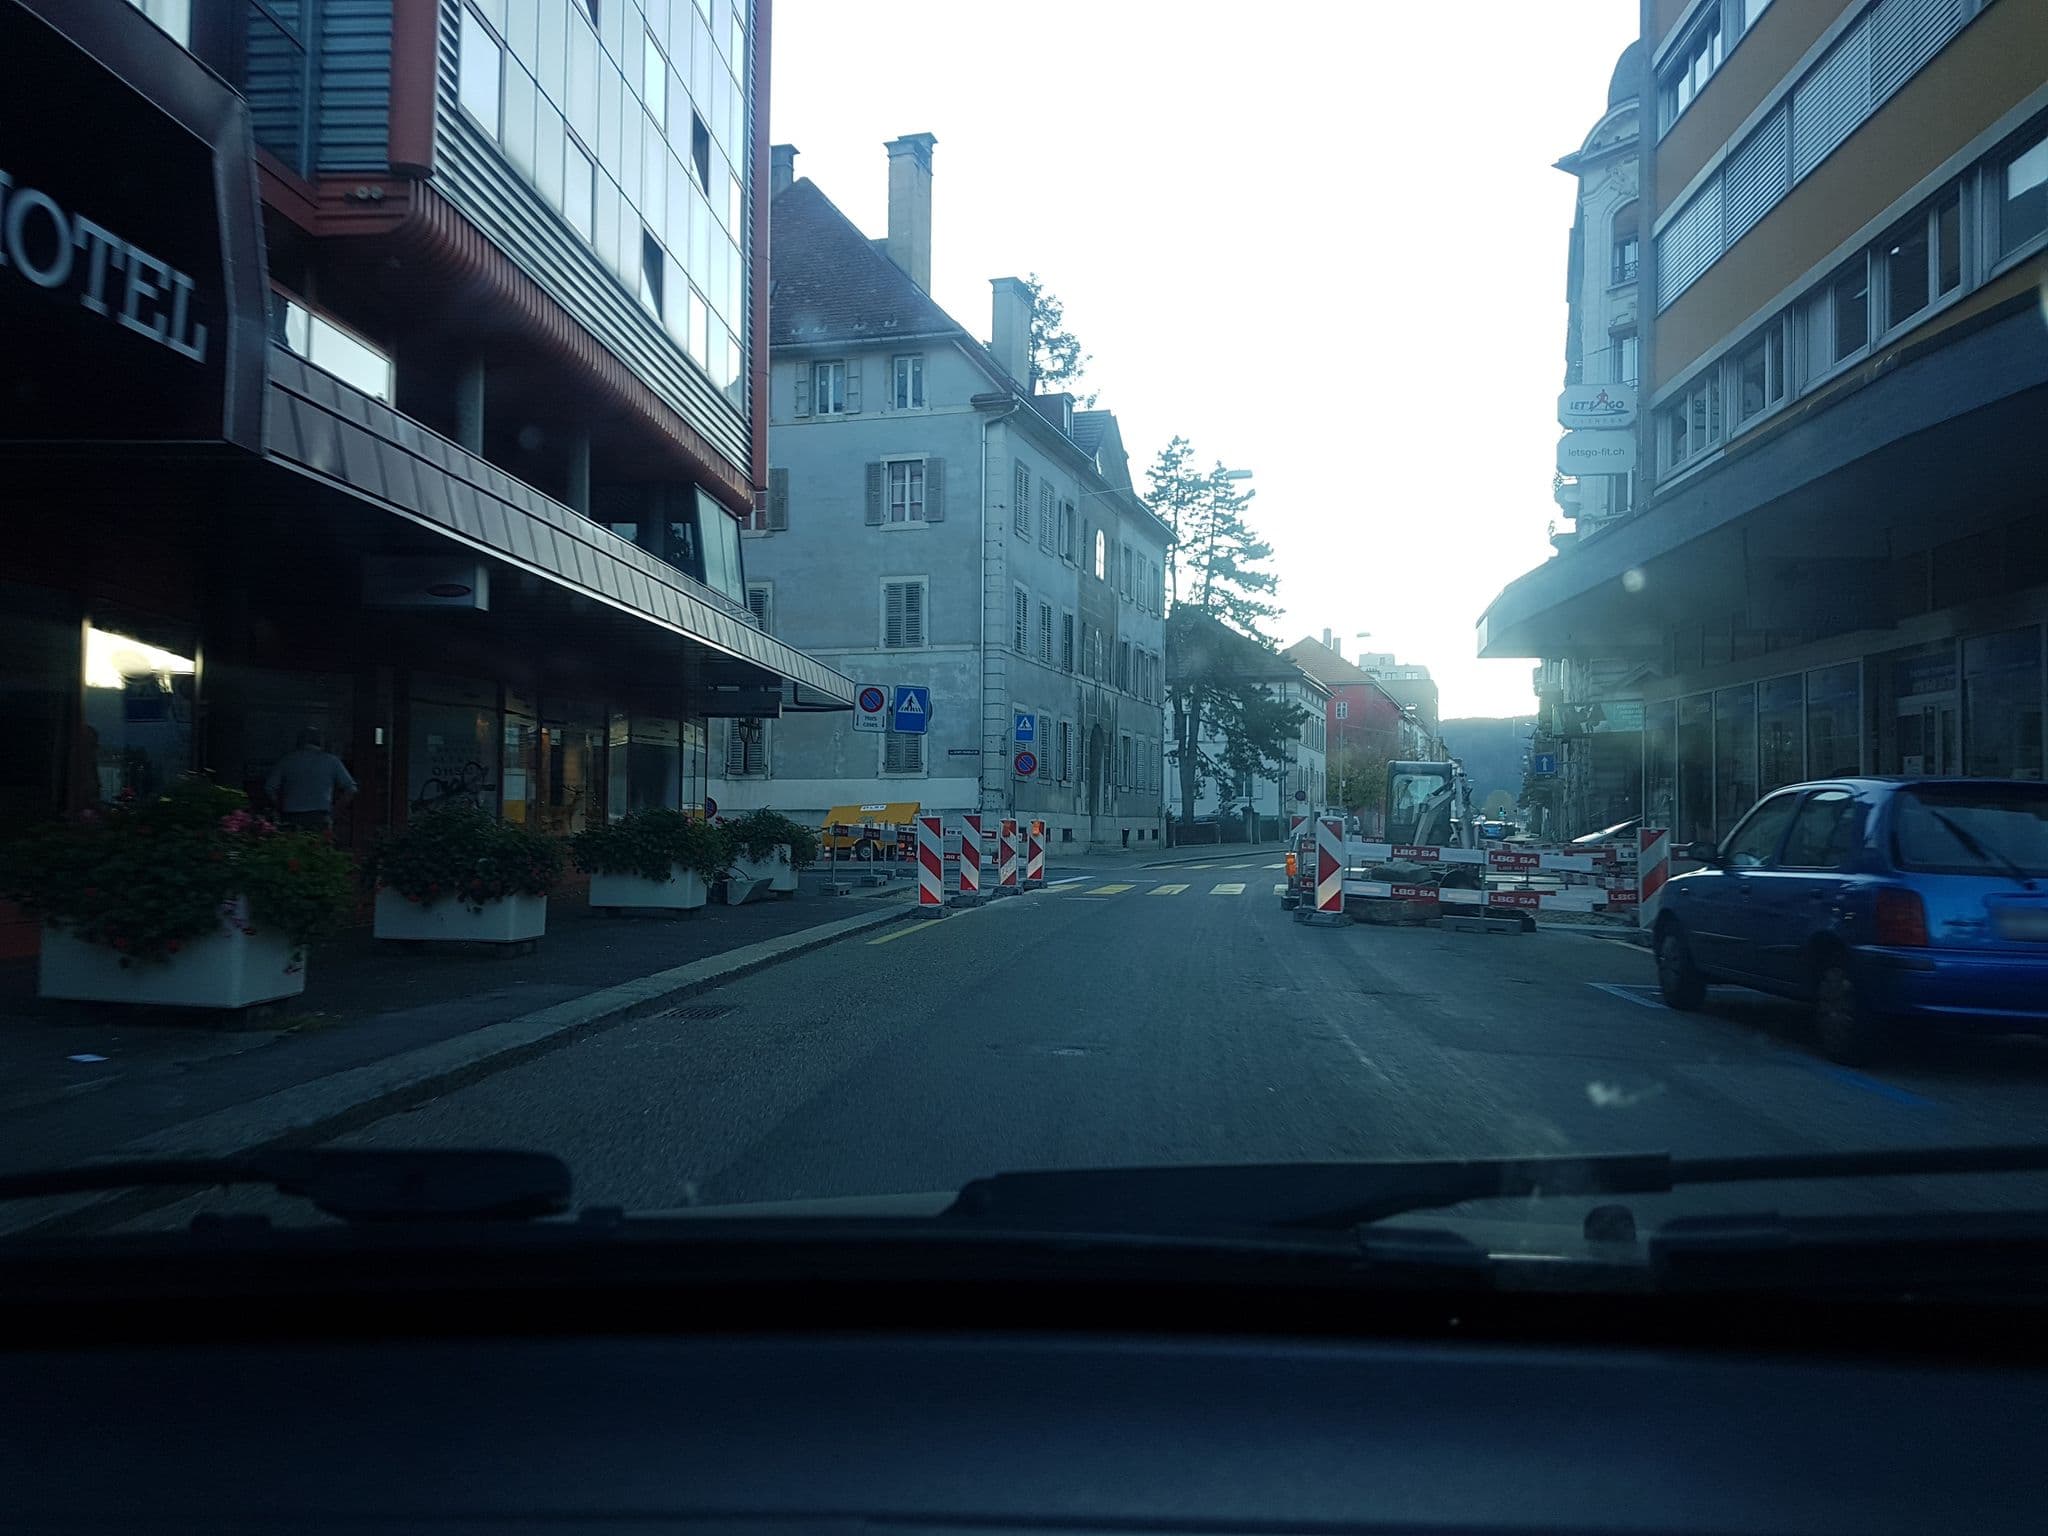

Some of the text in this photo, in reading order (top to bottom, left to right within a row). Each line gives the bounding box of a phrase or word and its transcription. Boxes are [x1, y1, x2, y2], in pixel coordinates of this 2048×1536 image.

[1608, 400, 1625, 409] GO
[1568, 447, 1625, 458] letsgo-fit.ch
[1393, 848, 1438, 858] LBG SA
[1490, 854, 1538, 865] LBG SA
[1392, 887, 1437, 898] LBG SA
[1610, 893, 1637, 901] LBG
[1490, 895, 1538, 905] LBG SA
